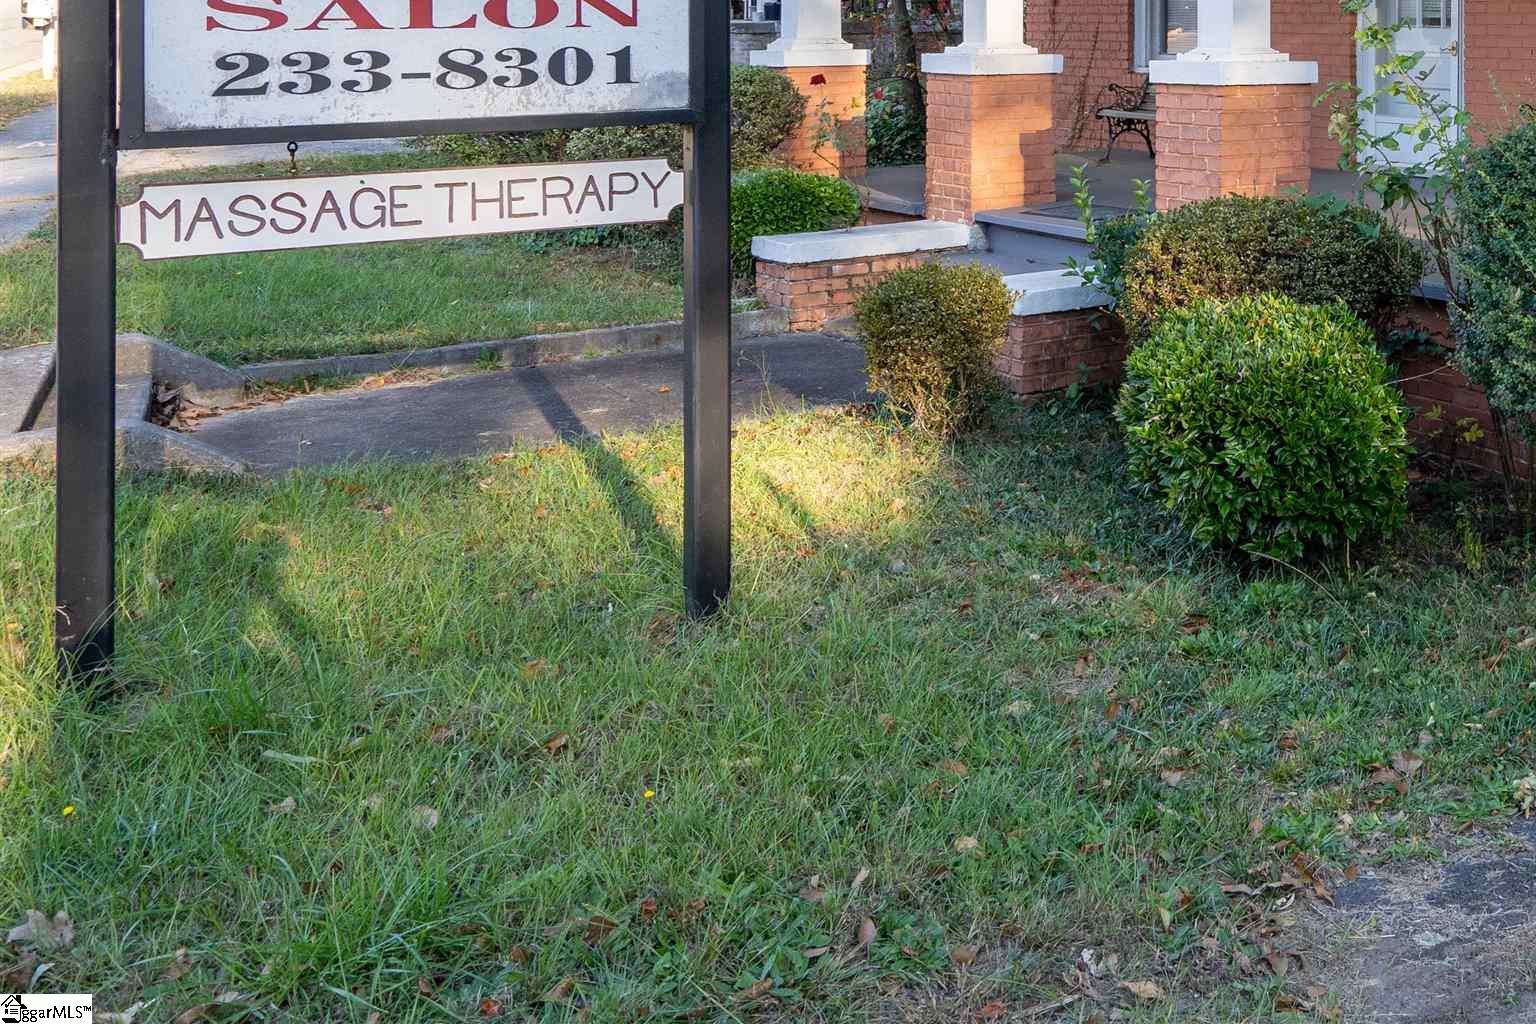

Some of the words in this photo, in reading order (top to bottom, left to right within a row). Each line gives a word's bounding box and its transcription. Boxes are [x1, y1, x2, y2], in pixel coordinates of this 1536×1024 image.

[211, 45, 640, 97] 233-8301
[139, 184, 423, 245] MASSAGE
[434, 170, 671, 223] THERAPY
